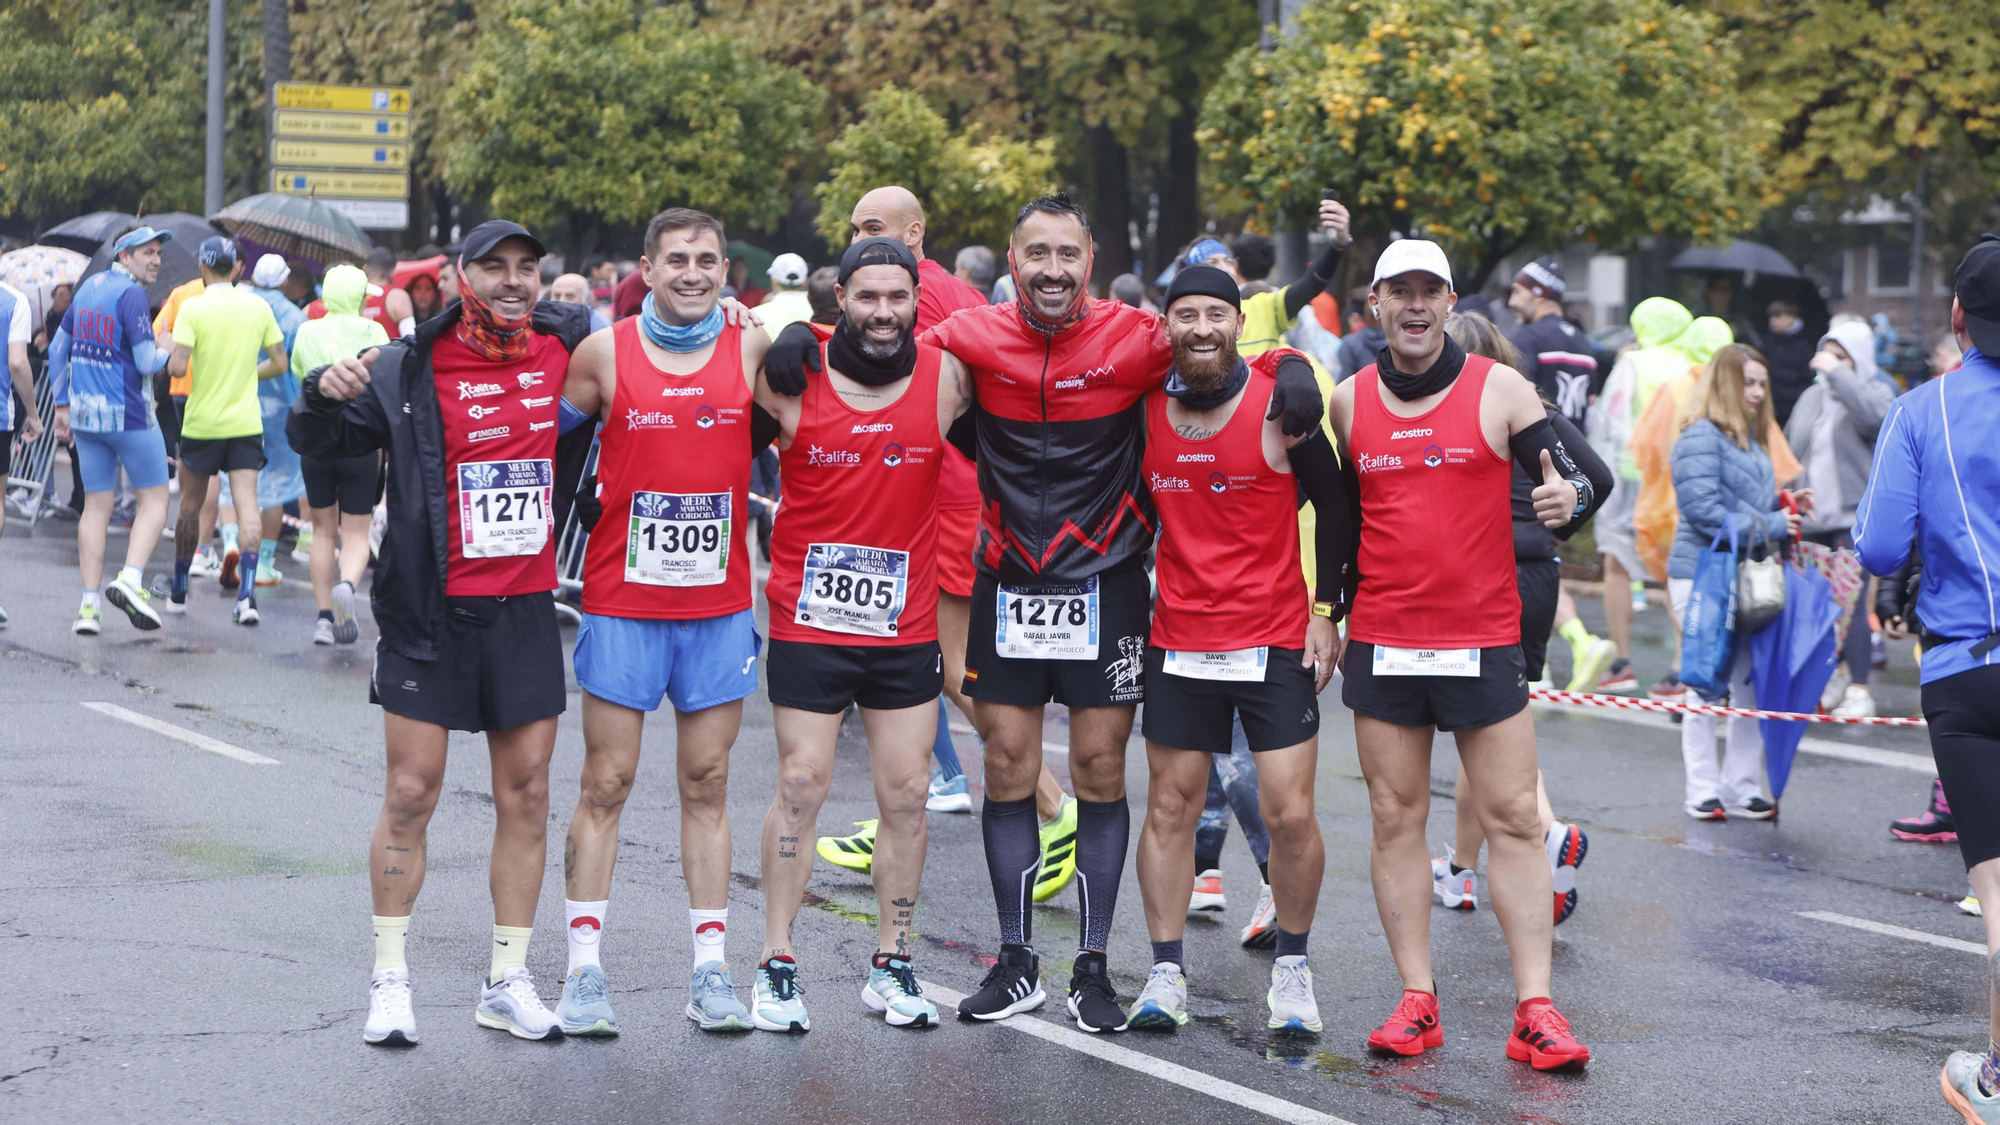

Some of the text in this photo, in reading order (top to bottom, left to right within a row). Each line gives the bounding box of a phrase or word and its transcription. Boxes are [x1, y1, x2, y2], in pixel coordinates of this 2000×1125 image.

[468, 384, 501, 394] califas
[1055, 379, 1085, 389] ROMPE
[662, 387, 704, 396] Mosttro
[635, 412, 674, 425] califas
[478, 426, 510, 437] IMDECO
[851, 423, 893, 433] Mosttro
[1390, 428, 1433, 440] Mosttro
[819, 450, 860, 463] califas
[1176, 453, 1216, 462] Mosttro
[1366, 454, 1401, 468] califas
[508, 462, 536, 472] MEDIA
[472, 473, 493, 487] 59
[1157, 476, 1190, 489] califas
[475, 491, 542, 523] 1271
[680, 496, 713, 505] MEDIA
[643, 502, 663, 517] 59
[489, 528, 537, 537] JUAN FRANCISCO
[643, 523, 719, 553] 1309
[818, 554, 838, 567] 59
[855, 548, 888, 561] MEDIA
[661, 559, 697, 567] FRANCISCO
[894, 559, 902, 575] 202
[815, 572, 894, 609] 3805
[827, 606, 843, 616] JOSE
[844, 610, 871, 620] MANUEL
[1009, 598, 1086, 626] 1278
[1049, 632, 1071, 640] JAVIER
